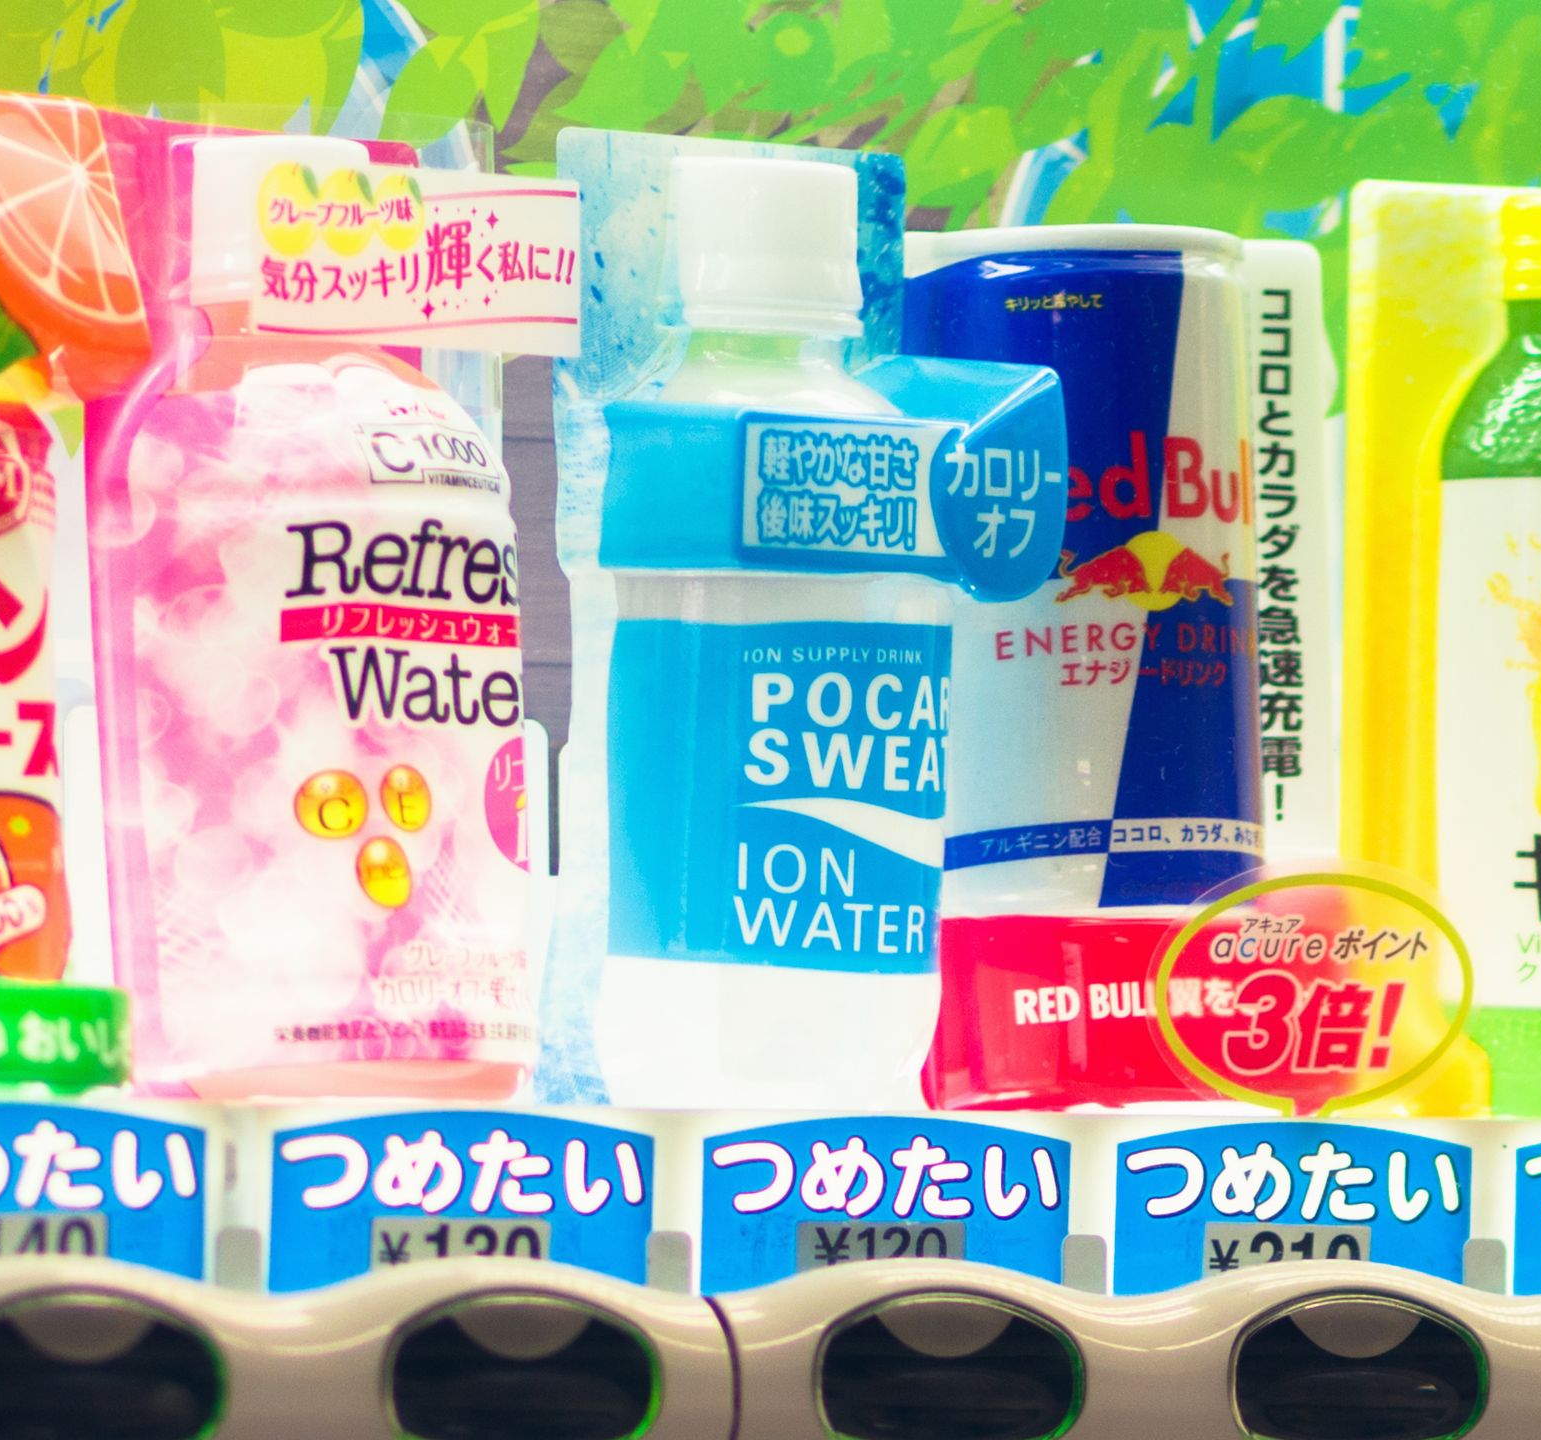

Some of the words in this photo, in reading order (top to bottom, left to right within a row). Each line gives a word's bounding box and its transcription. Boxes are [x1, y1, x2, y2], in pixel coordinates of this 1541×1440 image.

[268, 193, 415, 228] グレープフルーツ味
[758, 436, 919, 491] 軽やかな甘さ
[945, 442, 1062, 500] カロリー
[756, 491, 916, 553] 後味スッキリ!
[972, 507, 1034, 560] オフ
[1256, 287, 1304, 820] ココロとカラダを急速充電!
[744, 647, 785, 666] ION
[791, 648, 870, 665] SUPPLY
[876, 648, 923, 665] DRINK
[995, 622, 1159, 662] ENERGY
[331, 645, 522, 727] Wate
[1060, 656, 1227, 688] エナジードリンク
[751, 671, 951, 732] POCAR
[737, 842, 856, 900] ION
[732, 896, 928, 954] WATER
[1211, 932, 1324, 963] acure
[1333, 930, 1429, 963] ポイント
[1243, 917, 1302, 935] アキュア
[1014, 985, 1080, 1025] RED
[1090, 982, 1158, 1020] BULL
[1221, 967, 1407, 1076] 3倍!
[280, 1130, 644, 1218] つめたい
[711, 1134, 1060, 1222] つめたい
[1124, 1140, 1462, 1226] つめたい
